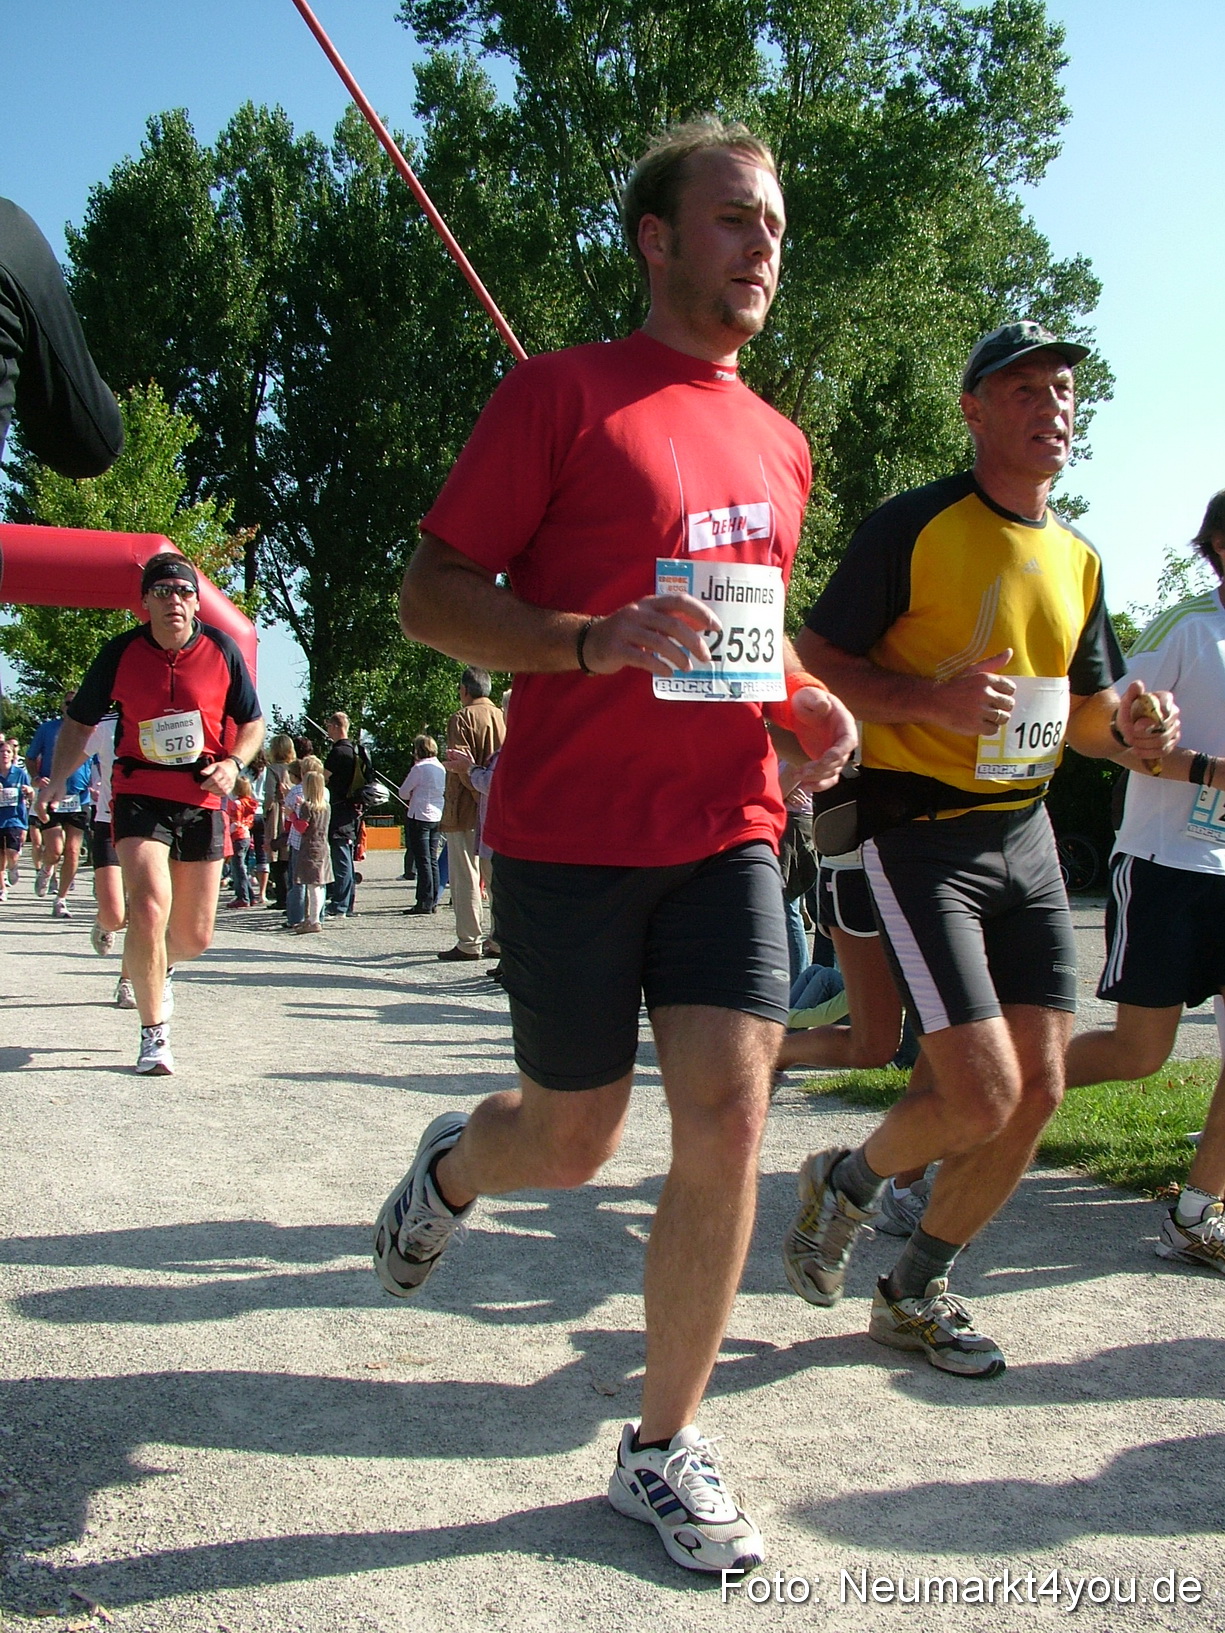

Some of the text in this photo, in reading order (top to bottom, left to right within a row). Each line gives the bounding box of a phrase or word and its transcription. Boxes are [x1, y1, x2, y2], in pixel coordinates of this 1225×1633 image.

[712, 515, 748, 536] DEHN
[701, 575, 774, 604] Johannes
[703, 626, 774, 663] 2533
[655, 679, 713, 694] BOCK
[156, 719, 194, 733] Johannes
[1014, 720, 1062, 749] 1068
[165, 734, 195, 752] 578
[978, 764, 1018, 775] BOCK
